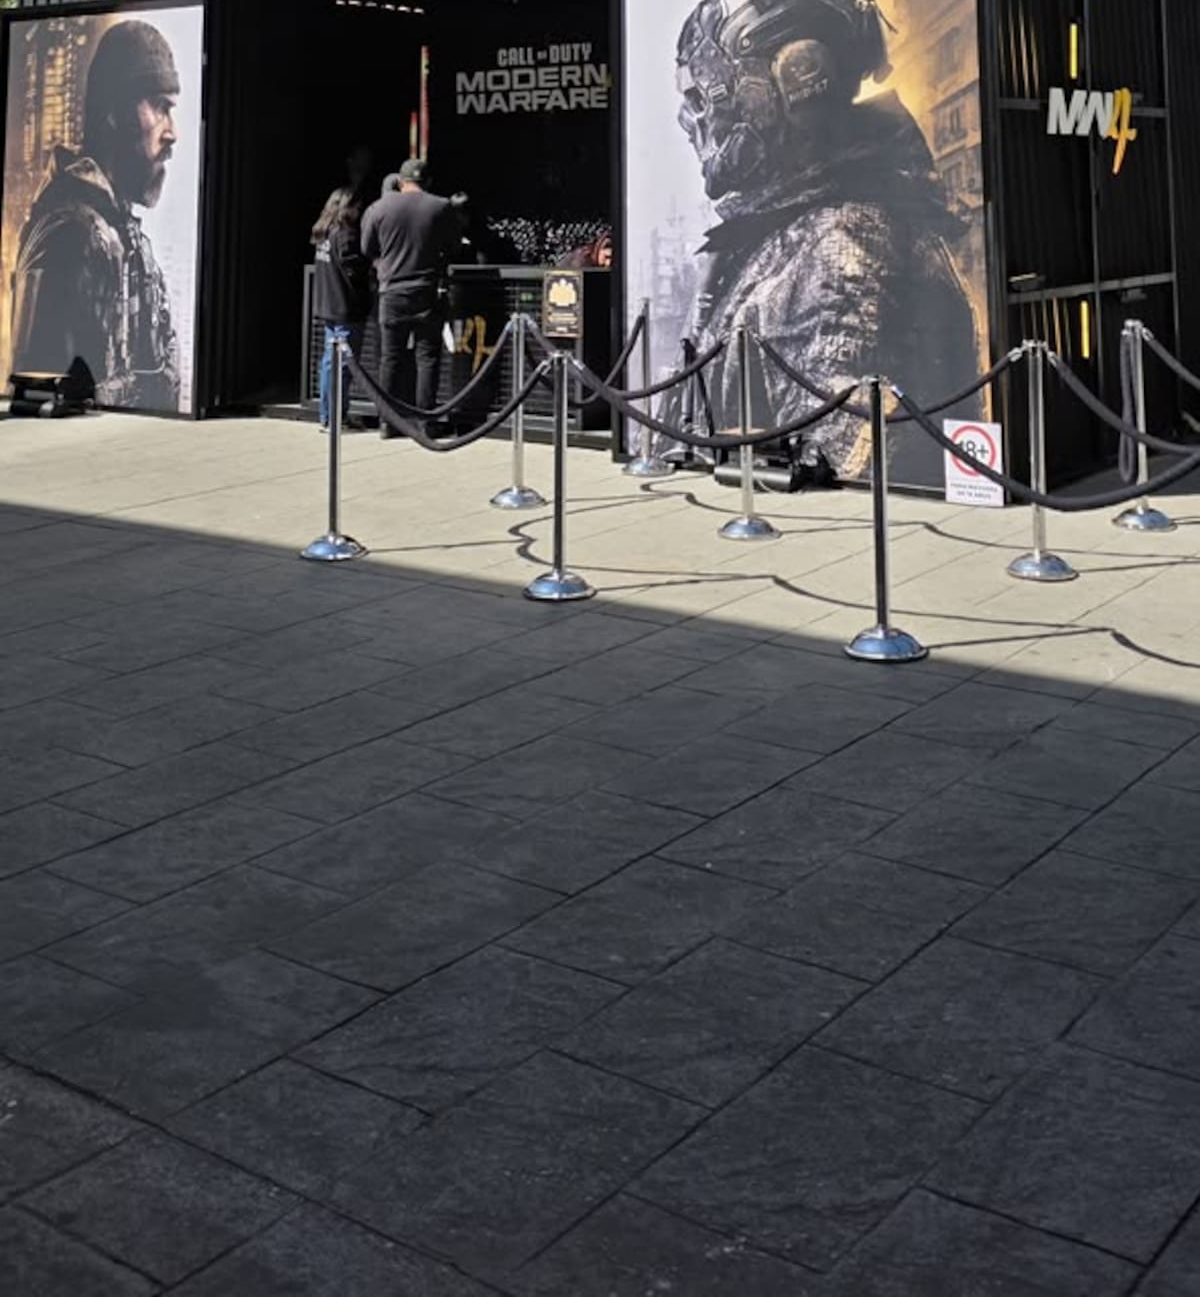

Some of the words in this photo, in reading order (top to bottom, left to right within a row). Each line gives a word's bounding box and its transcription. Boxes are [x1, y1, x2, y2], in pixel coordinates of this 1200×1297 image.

[497, 46, 535, 68] CALL
[549, 42, 592, 64] DUTY
[456, 63, 608, 93] MODERN
[456, 86, 608, 115] WARFARE
